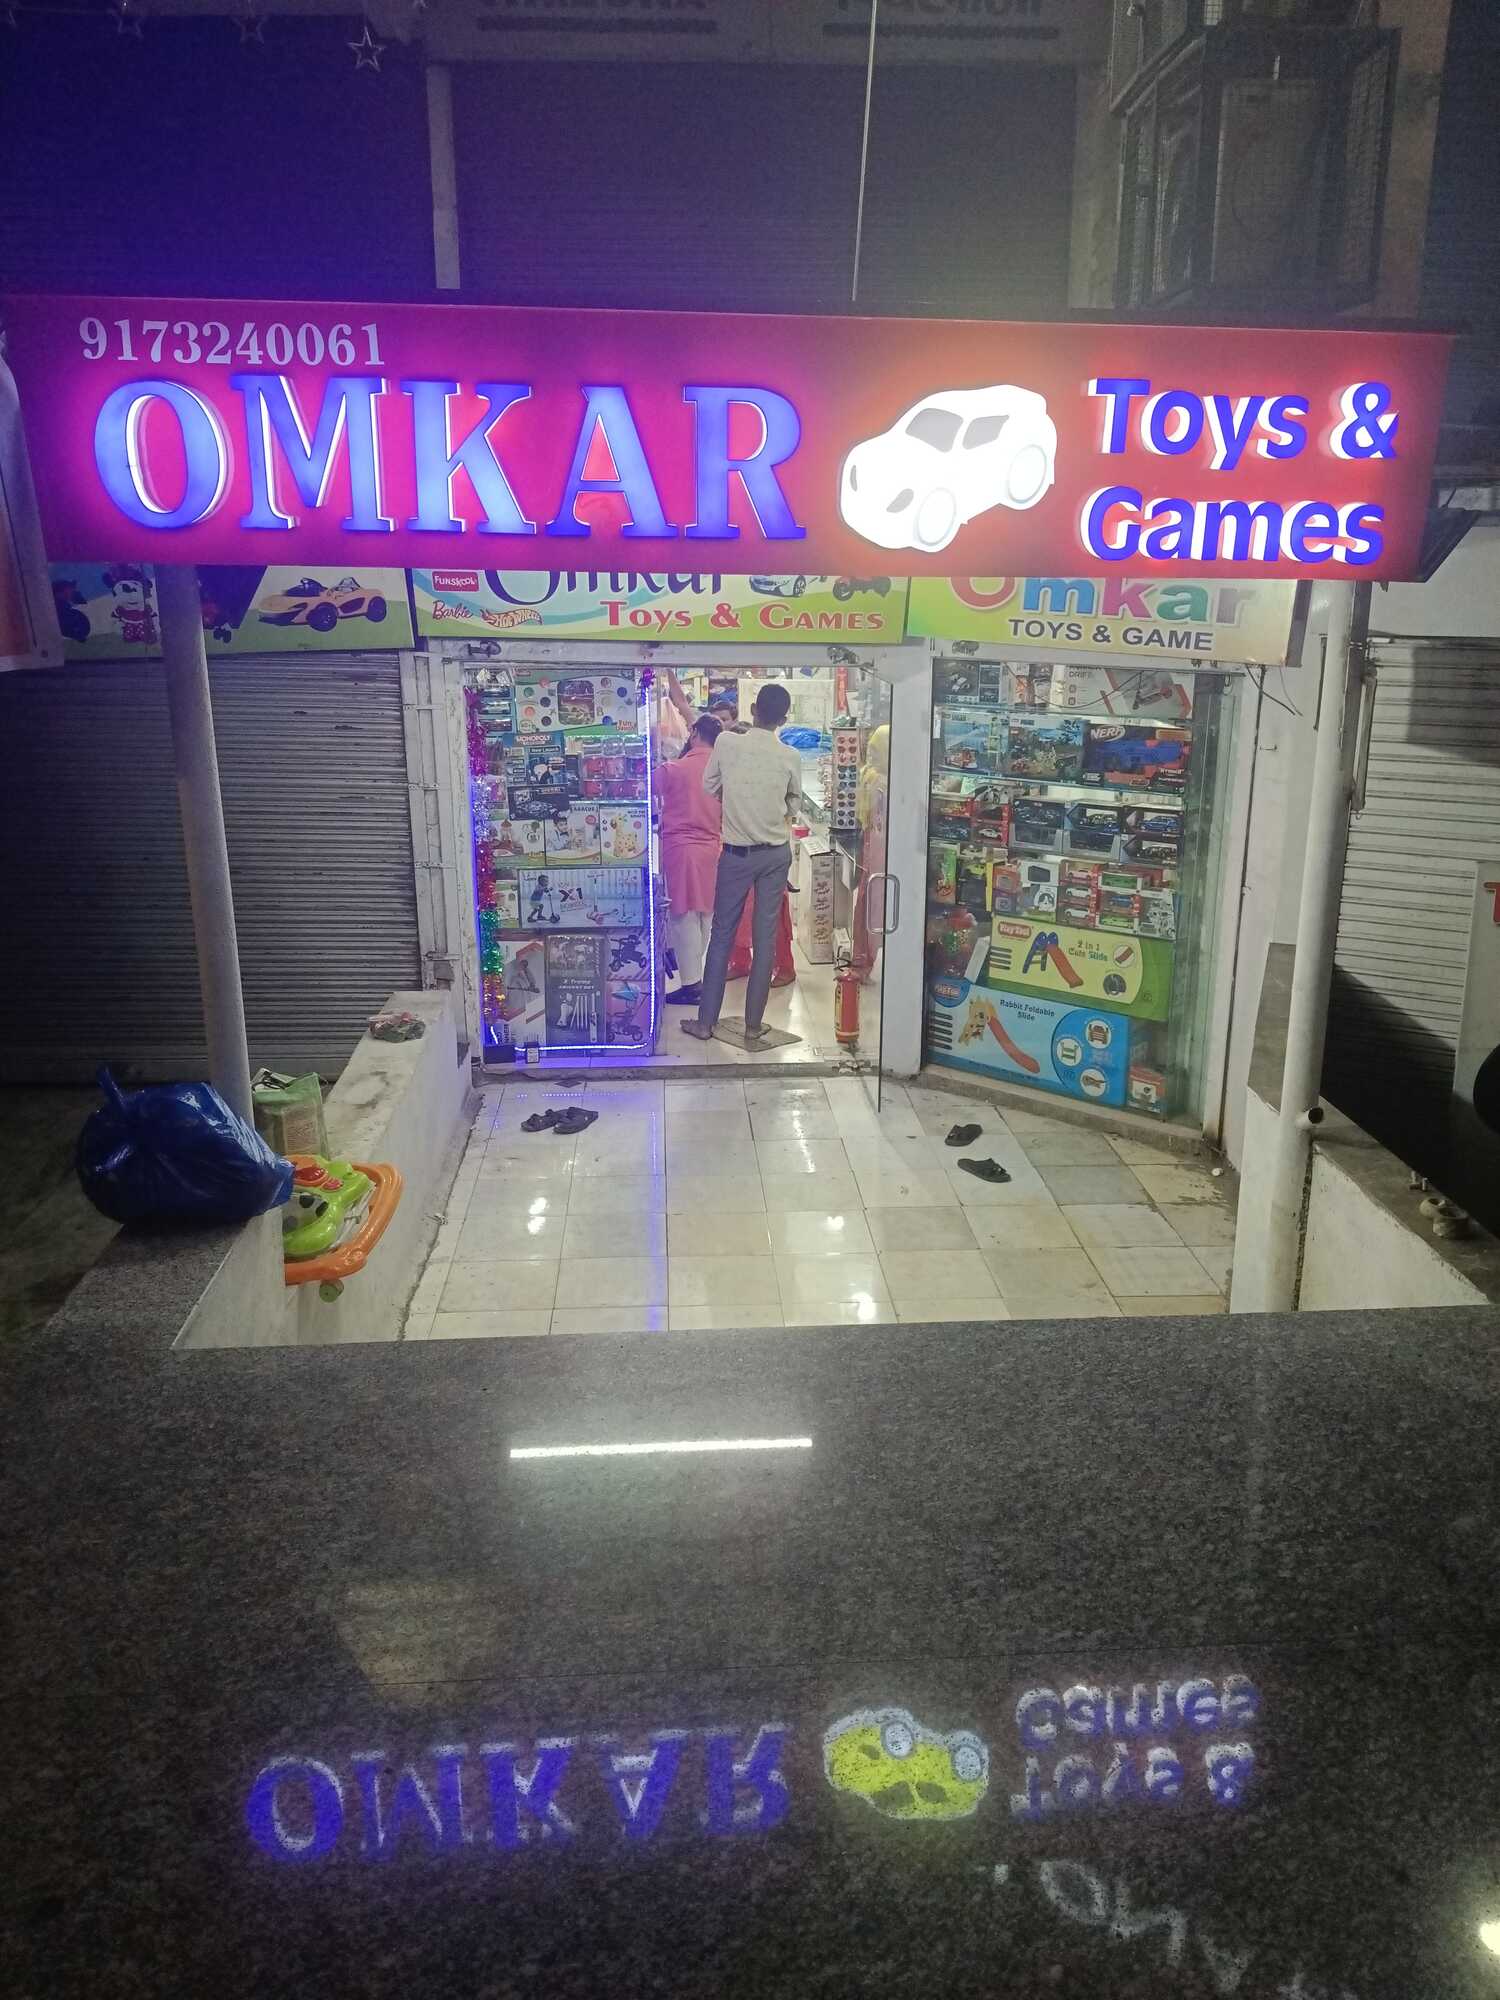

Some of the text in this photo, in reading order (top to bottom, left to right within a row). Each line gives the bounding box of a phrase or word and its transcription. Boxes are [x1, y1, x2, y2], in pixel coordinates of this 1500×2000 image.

[80, 317, 385, 366] 9173240061
[1088, 378, 1399, 470] Toys &
[94, 374, 806, 539] OMKAR
[1080, 485, 1384, 565] Games
[600, 600, 691, 632] Toys
[710, 603, 740, 628] &
[1008, 619, 1213, 650] TOYS & GAME
